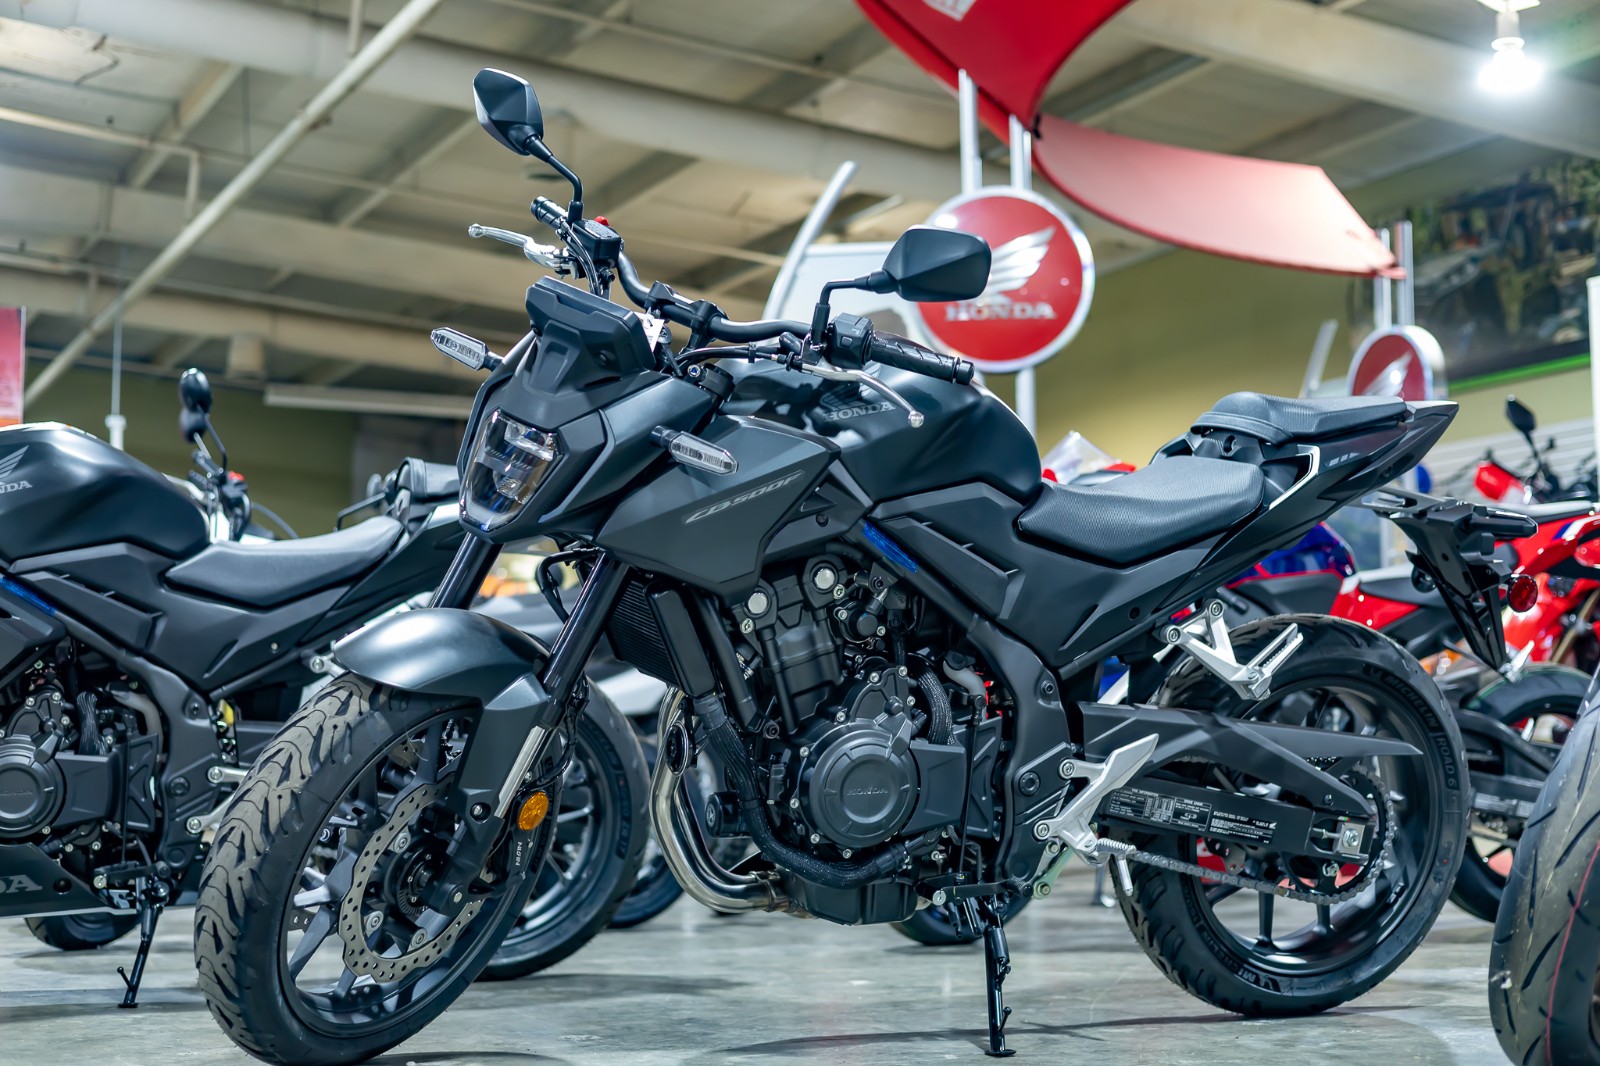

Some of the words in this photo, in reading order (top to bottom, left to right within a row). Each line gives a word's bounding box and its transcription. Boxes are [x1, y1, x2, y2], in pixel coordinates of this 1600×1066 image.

[945, 301, 1058, 321] HONDA
[822, 401, 896, 422] HONDA
[685, 469, 805, 524] CB500F
[1385, 674, 1439, 729] MICHELIN
[1437, 737, 1456, 775] ROAD
